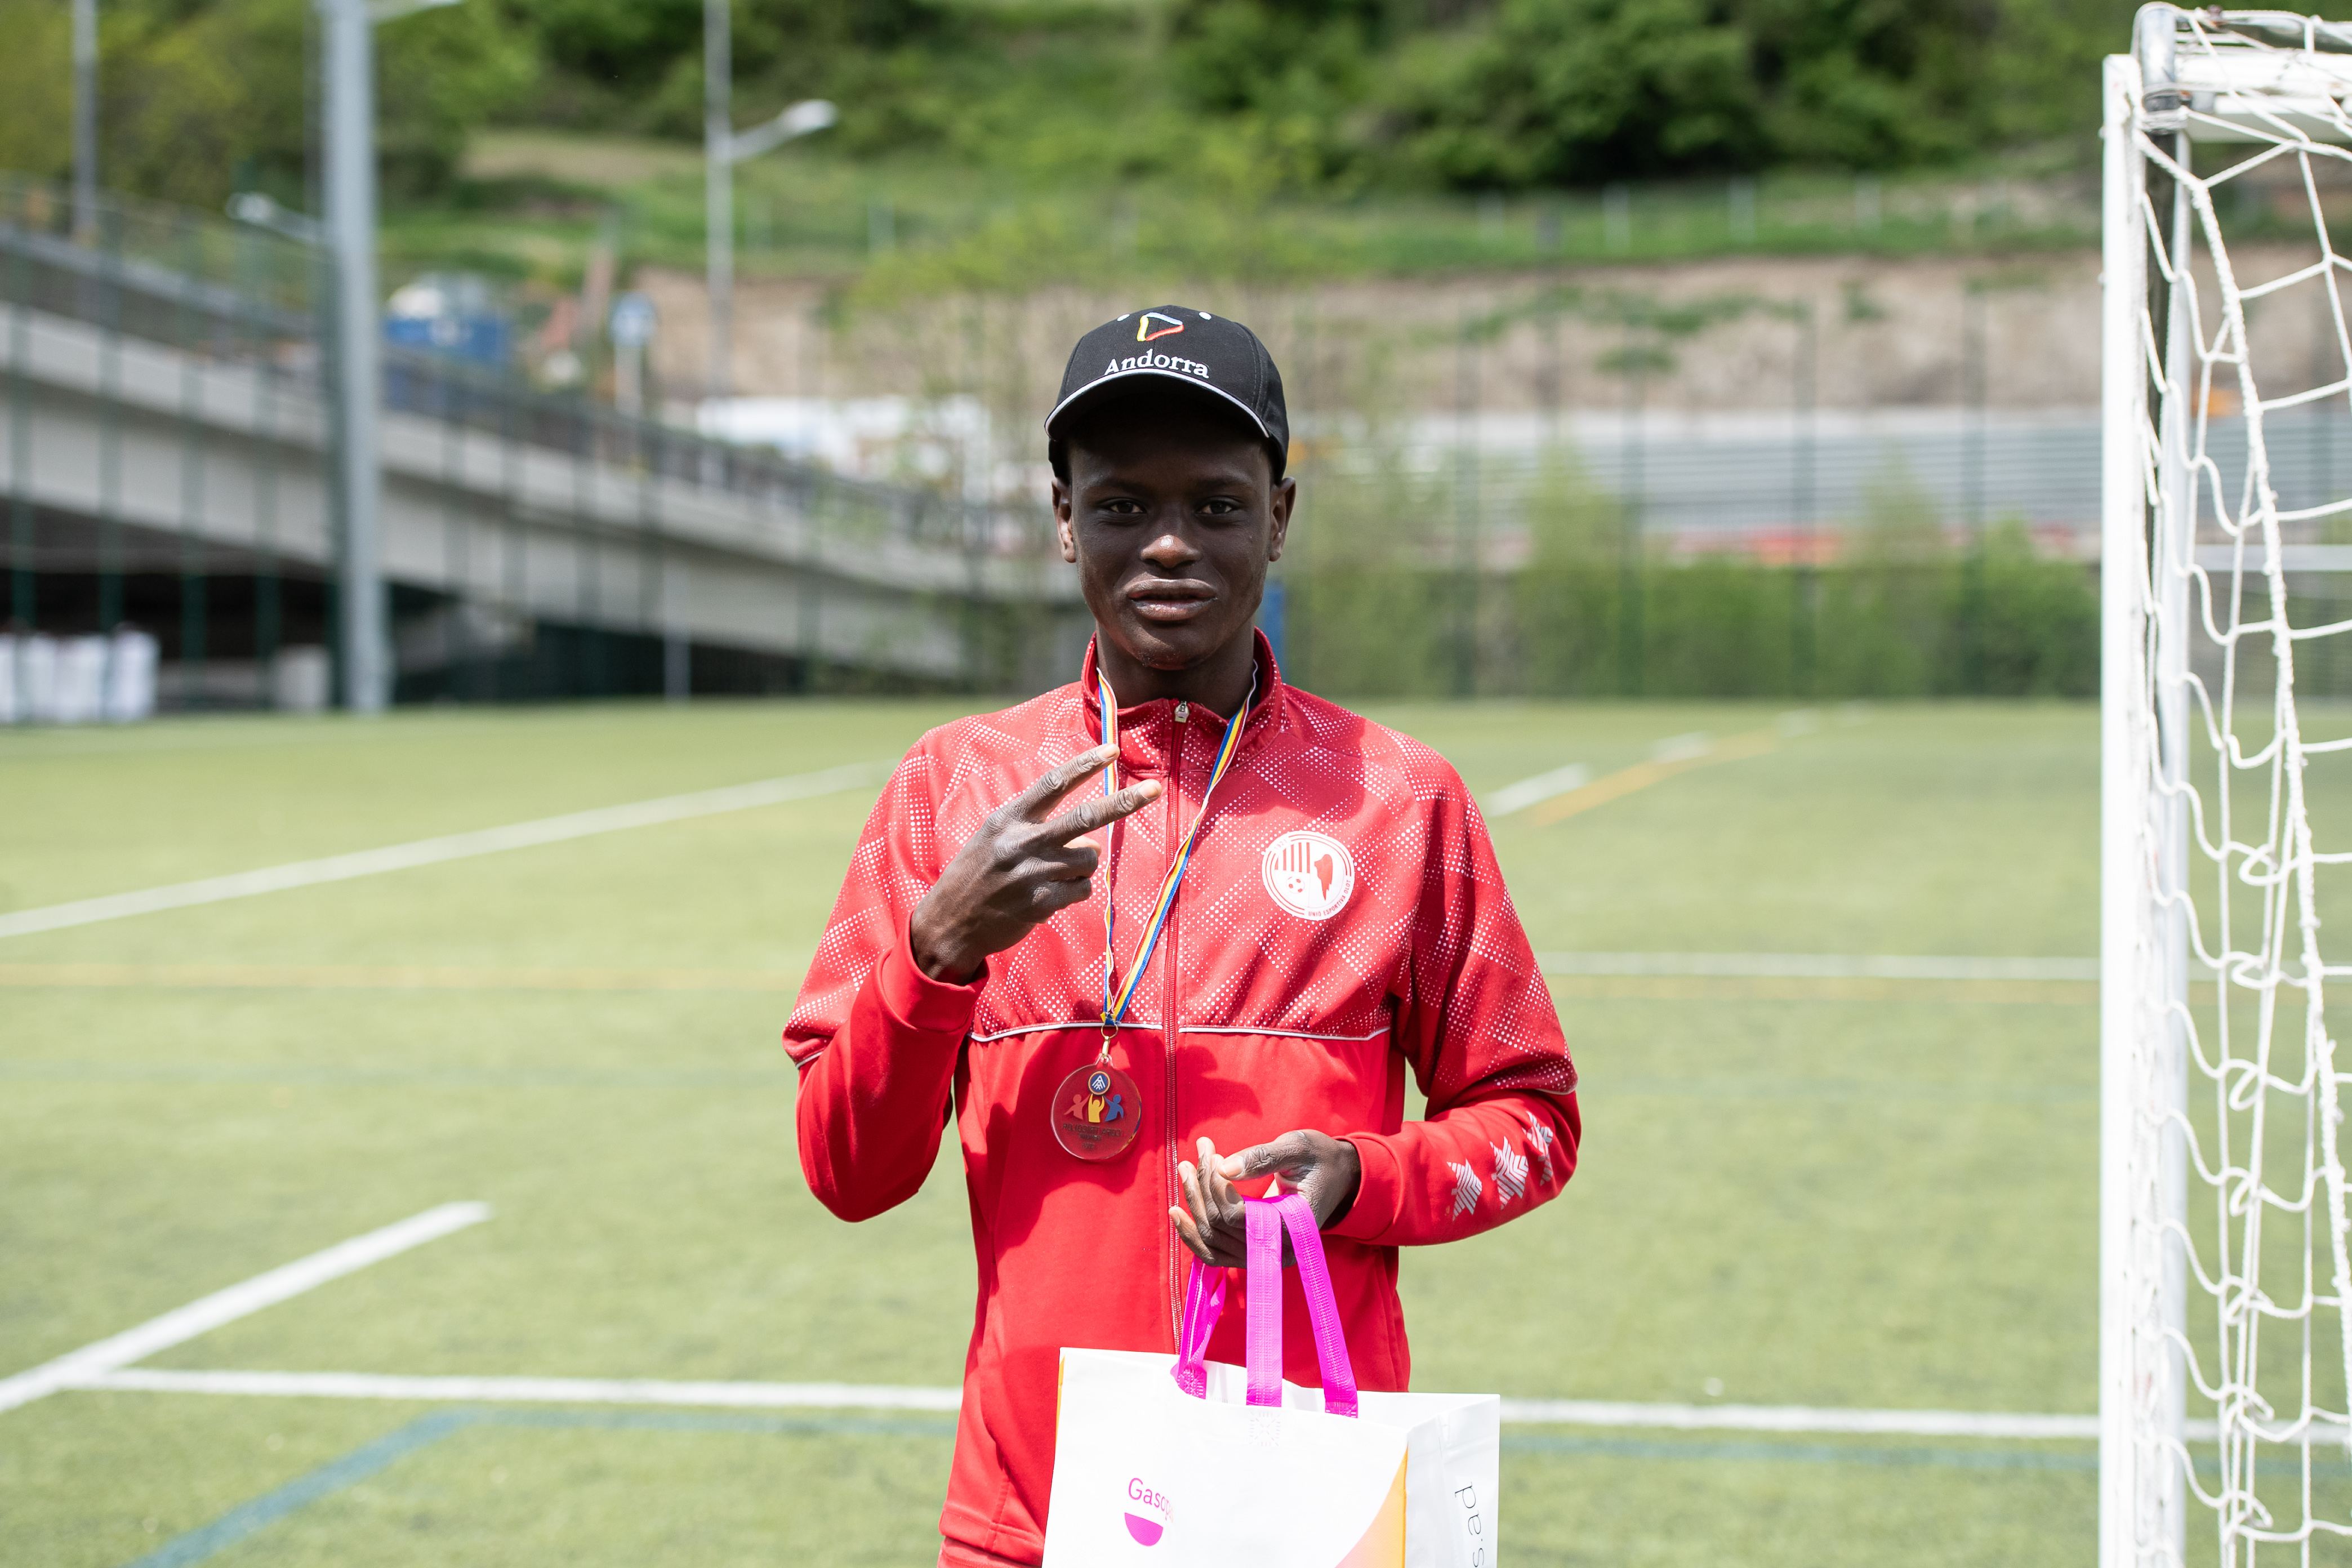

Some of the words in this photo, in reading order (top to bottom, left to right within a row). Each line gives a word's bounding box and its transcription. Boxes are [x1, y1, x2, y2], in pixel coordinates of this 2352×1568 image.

[1104, 348, 1209, 378] Andorra
[1274, 839, 1287, 851] 1921
[1323, 895, 1346, 916] ESPORTIVA
